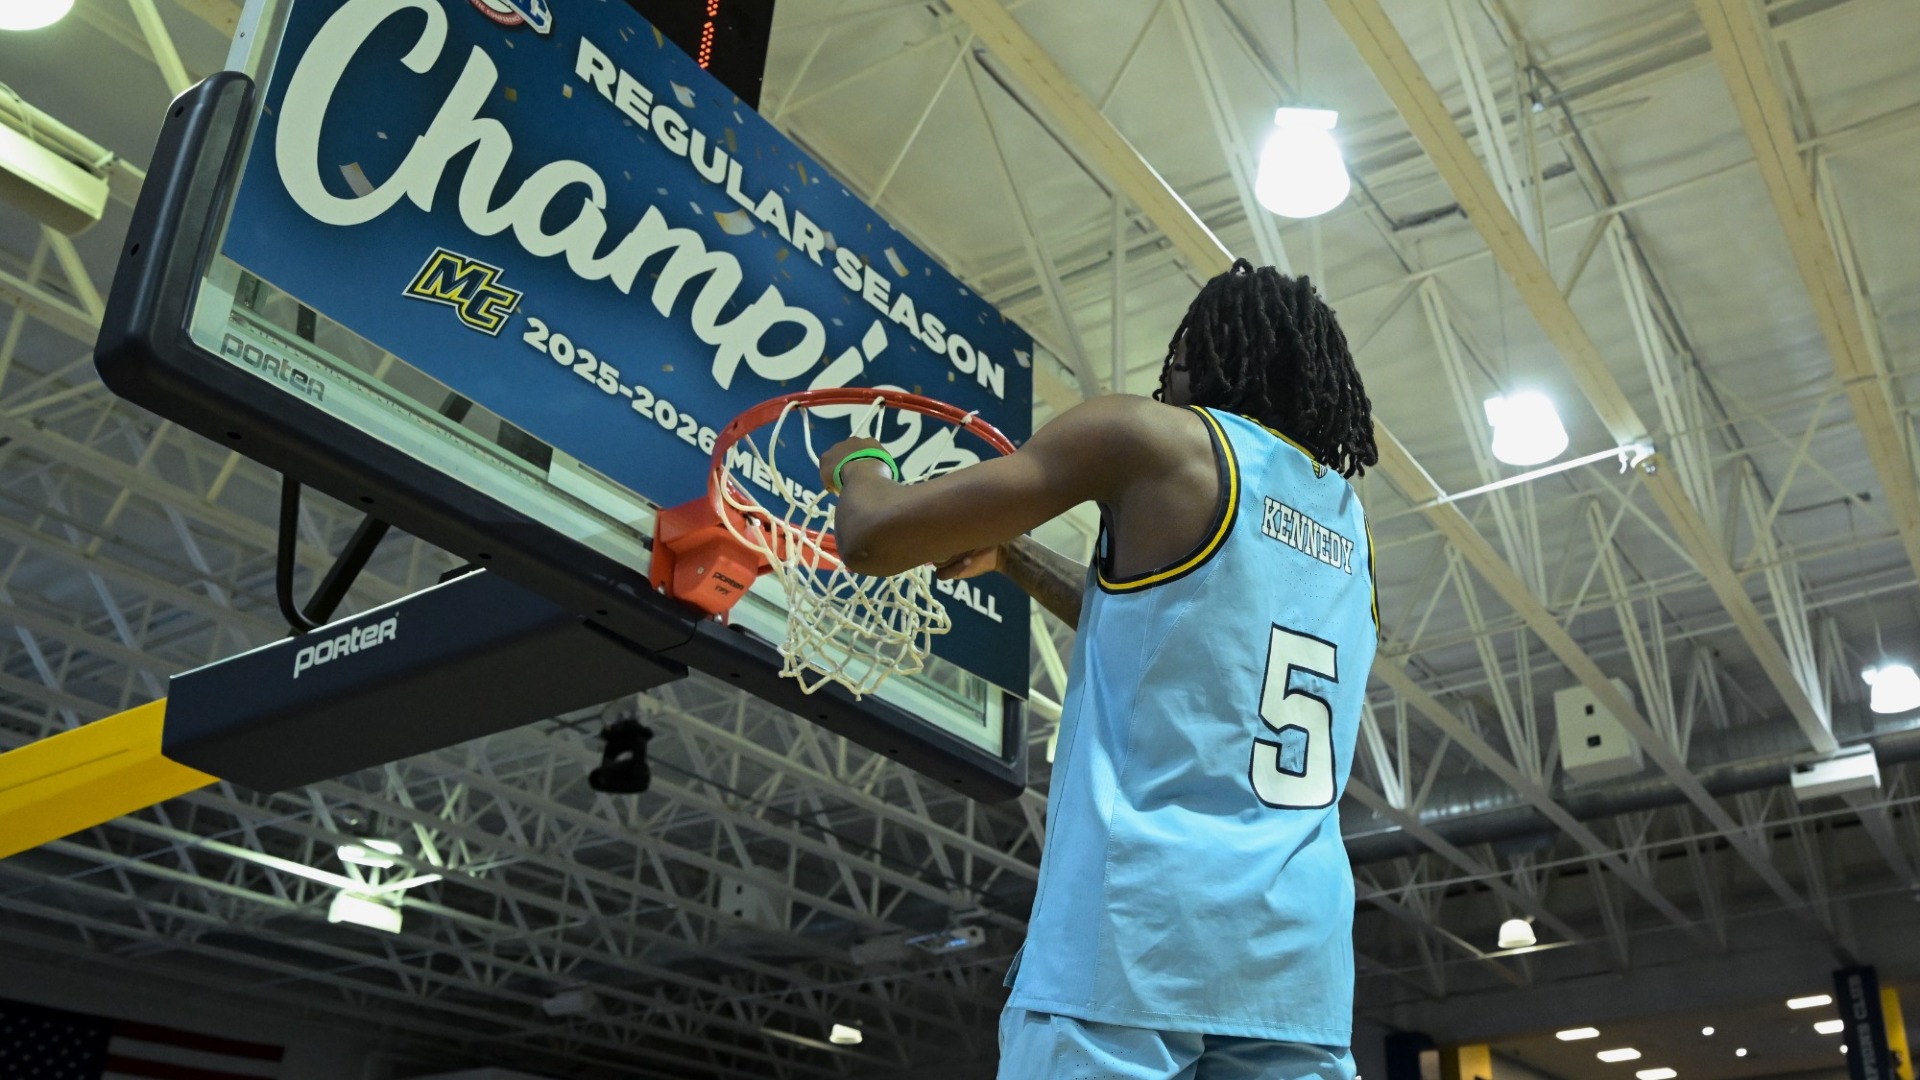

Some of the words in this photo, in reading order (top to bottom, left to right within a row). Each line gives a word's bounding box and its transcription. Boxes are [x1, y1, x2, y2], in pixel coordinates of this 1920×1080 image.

[275, 0, 982, 486] Champion
[402, 246, 524, 337] MC
[575, 36, 825, 267] REGULAR
[832, 251, 1005, 400] SEASON
[522, 317, 719, 456] 2025-2026
[725, 449, 821, 519] MEN'S
[1260, 495, 1355, 575] KENNEDY
[1248, 621, 1339, 810] 5
